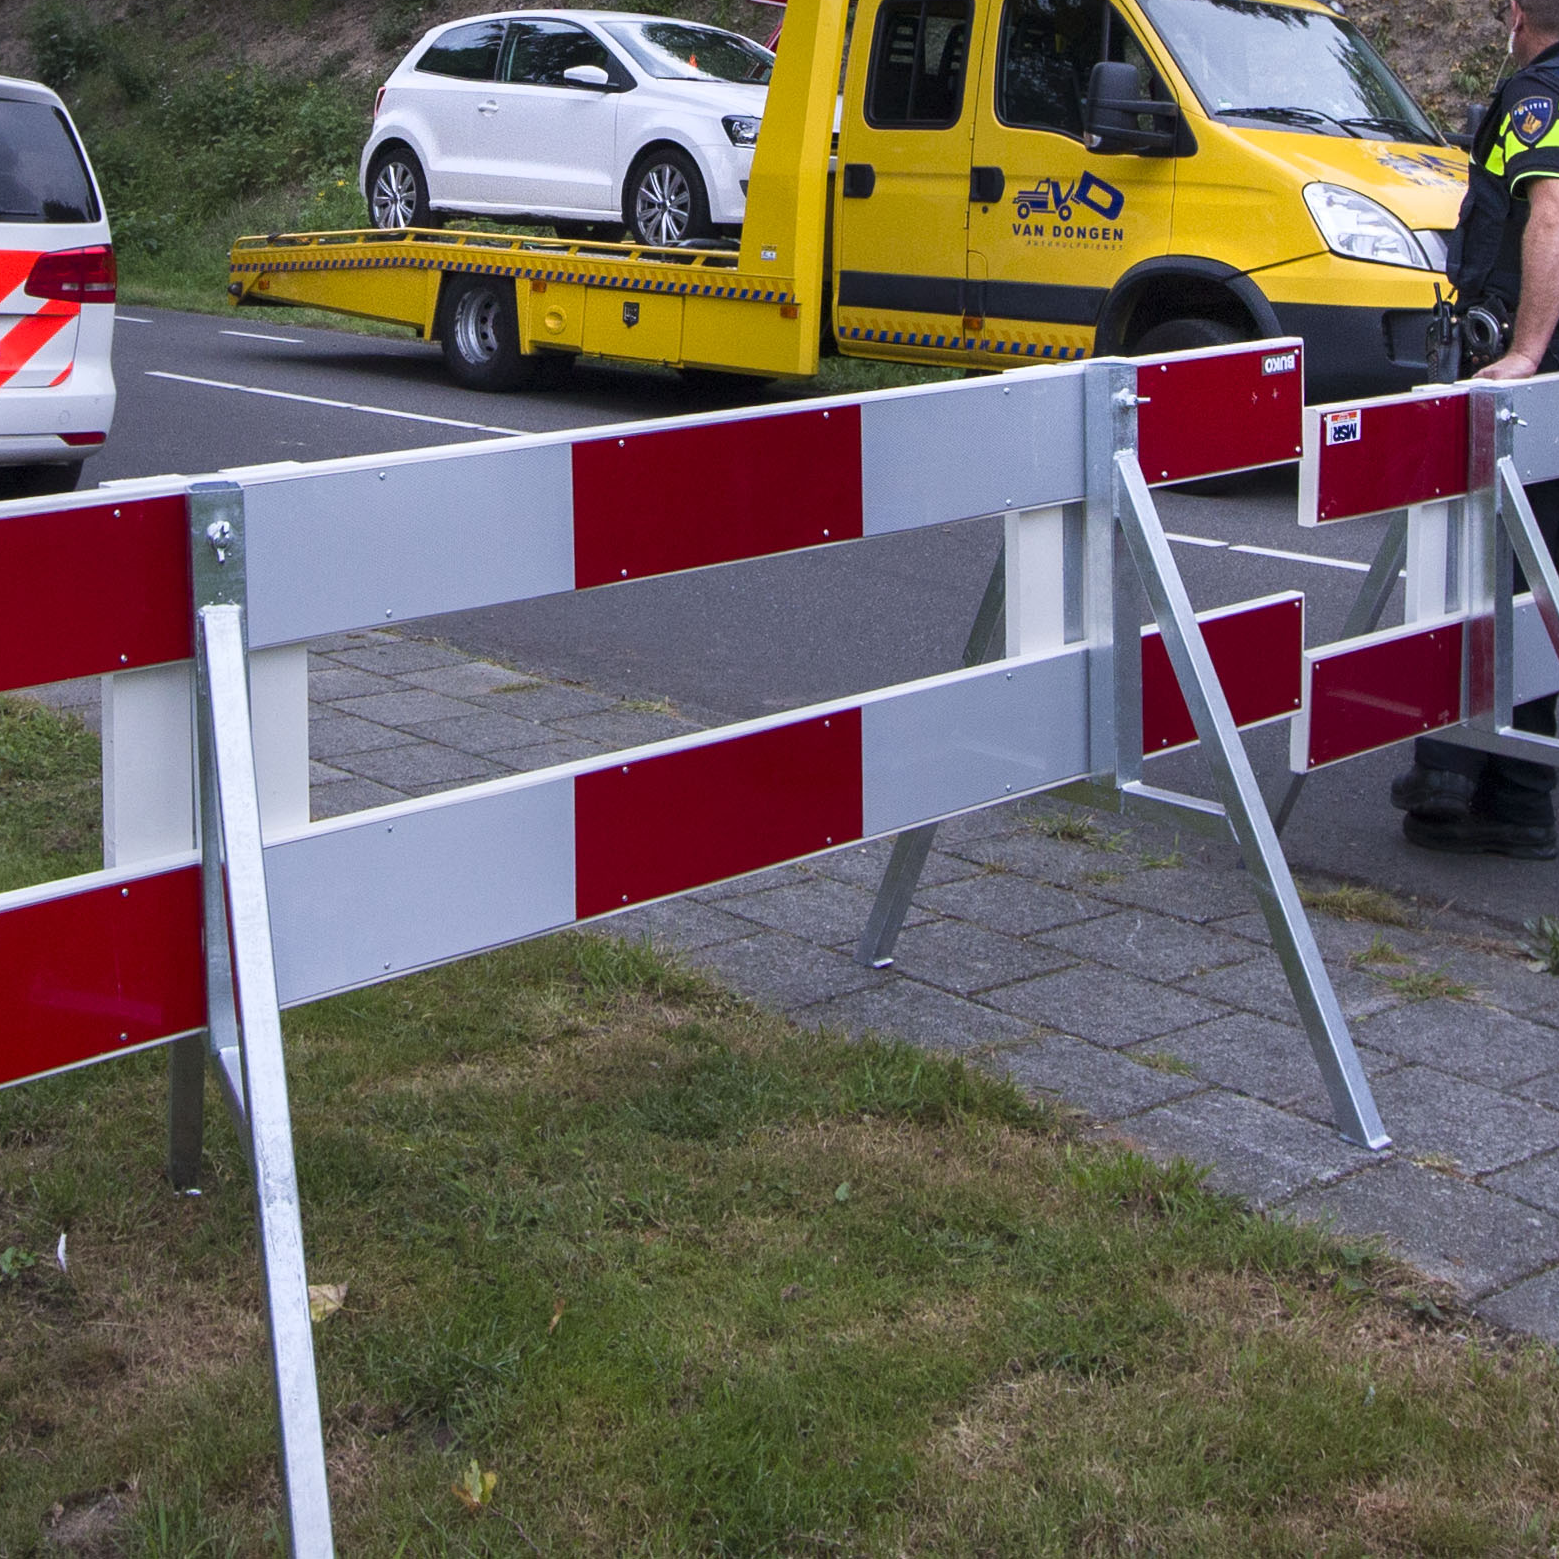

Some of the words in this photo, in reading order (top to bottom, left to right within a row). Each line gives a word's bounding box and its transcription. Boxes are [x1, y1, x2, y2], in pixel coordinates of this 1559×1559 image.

[1514, 102, 1548, 116] POLITIE
[1012, 223, 1044, 237] VAN
[1052, 225, 1124, 241] DONGEN
